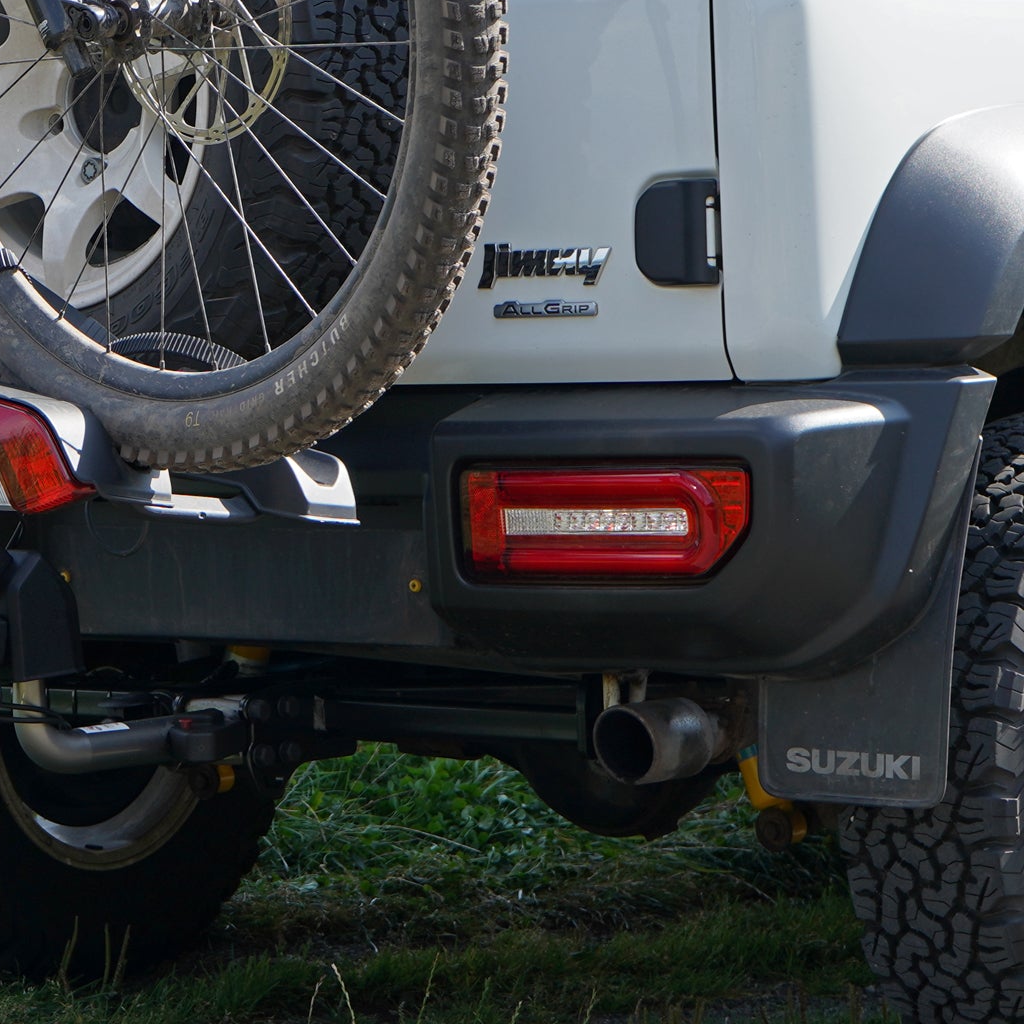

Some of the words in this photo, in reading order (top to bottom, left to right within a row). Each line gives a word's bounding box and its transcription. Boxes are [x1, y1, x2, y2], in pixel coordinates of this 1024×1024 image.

[477, 243, 612, 289] Jimny
[274, 312, 351, 396] BUTCHER
[785, 746, 921, 781] SUZUKI
